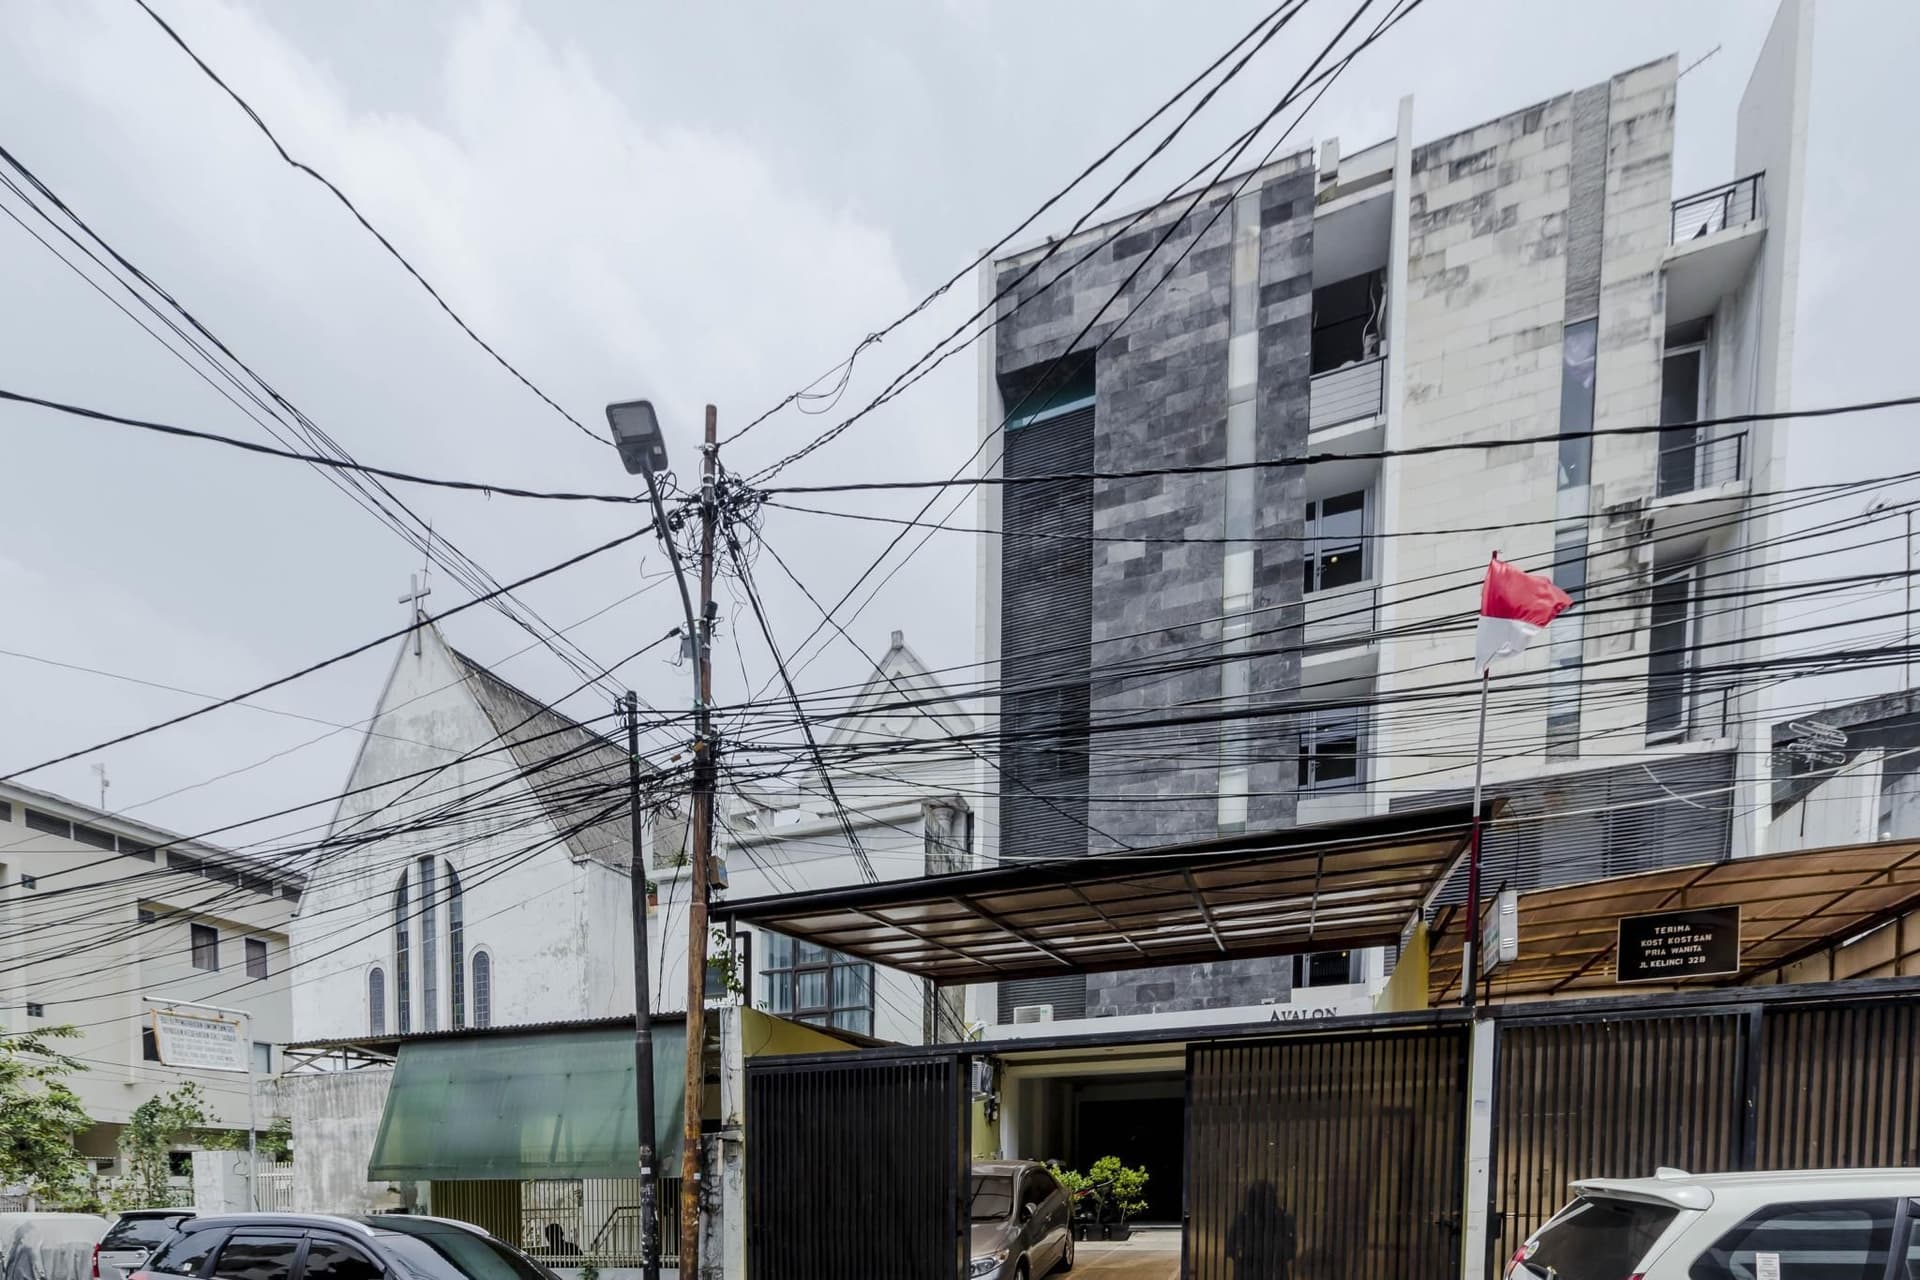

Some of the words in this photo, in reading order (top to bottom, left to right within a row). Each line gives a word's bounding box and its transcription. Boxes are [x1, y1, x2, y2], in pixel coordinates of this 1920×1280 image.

[1654, 925, 1691, 935] TERIMA
[1641, 938, 1663, 947] KOST
[1645, 948, 1666, 957] PRIA
[1671, 945, 1702, 954] WANITA
[1650, 958, 1683, 968] KELINCI
